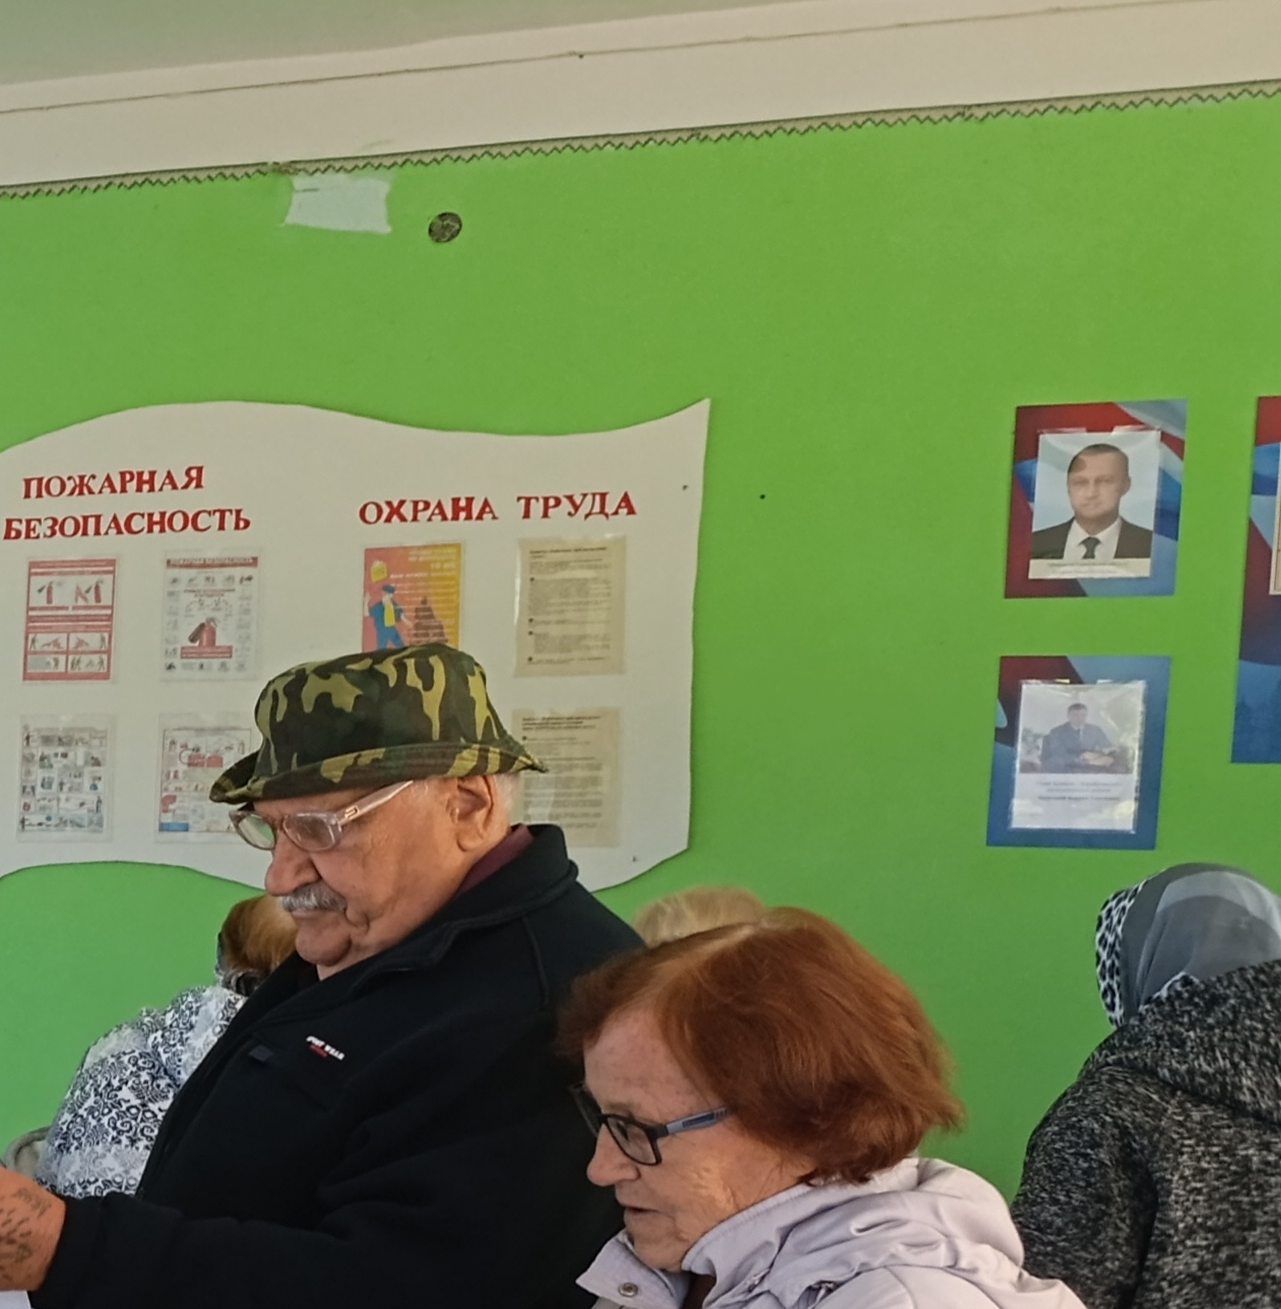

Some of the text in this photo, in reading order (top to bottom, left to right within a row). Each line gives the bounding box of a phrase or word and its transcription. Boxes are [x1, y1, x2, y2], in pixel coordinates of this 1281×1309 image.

[23, 466, 205, 500] ПОЖАРНАЯ
[4, 508, 252, 541] БЕЗОПАСНОСТЬ
[359, 491, 638, 525] ОХРАНА ТРУДА
